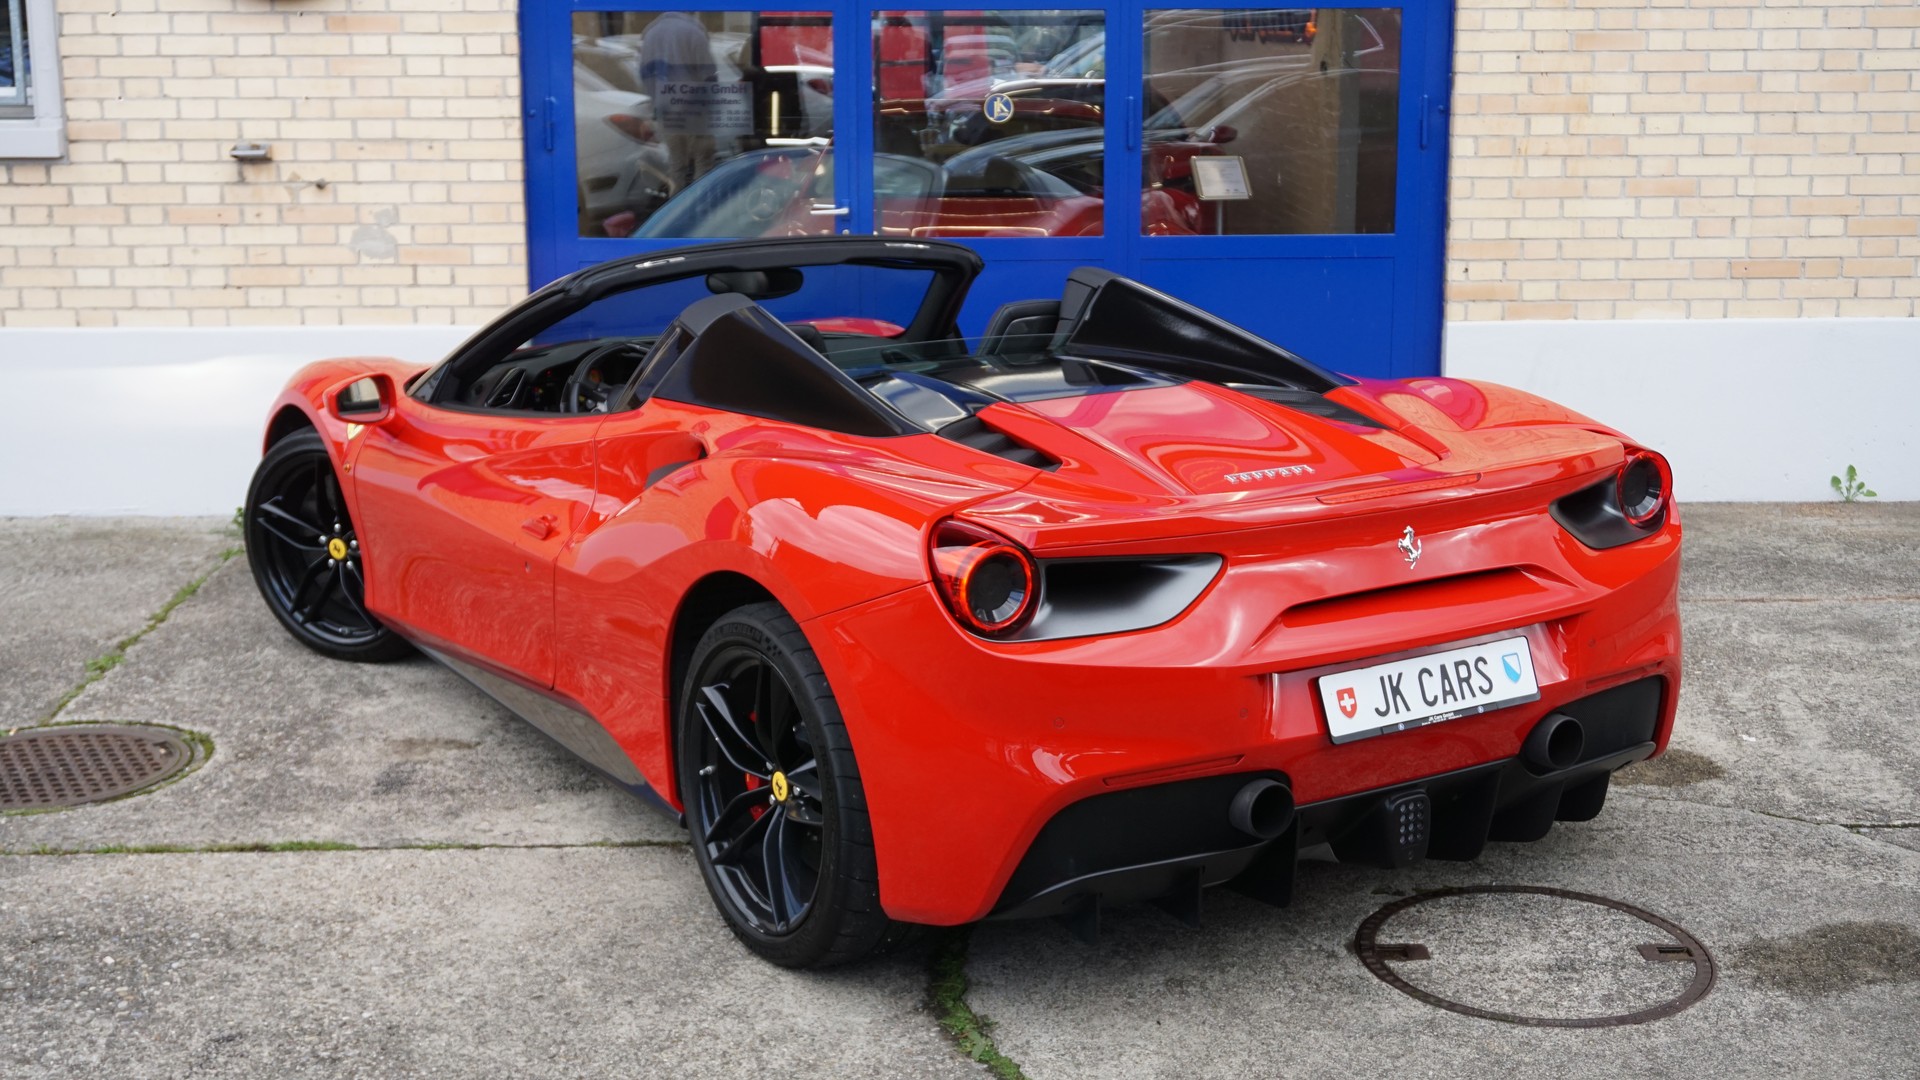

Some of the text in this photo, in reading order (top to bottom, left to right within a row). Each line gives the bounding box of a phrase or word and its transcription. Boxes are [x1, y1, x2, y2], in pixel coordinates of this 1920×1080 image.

[661, 84, 747, 95] JK Cars GmbH
[1374, 656, 1494, 717] JK CARS
